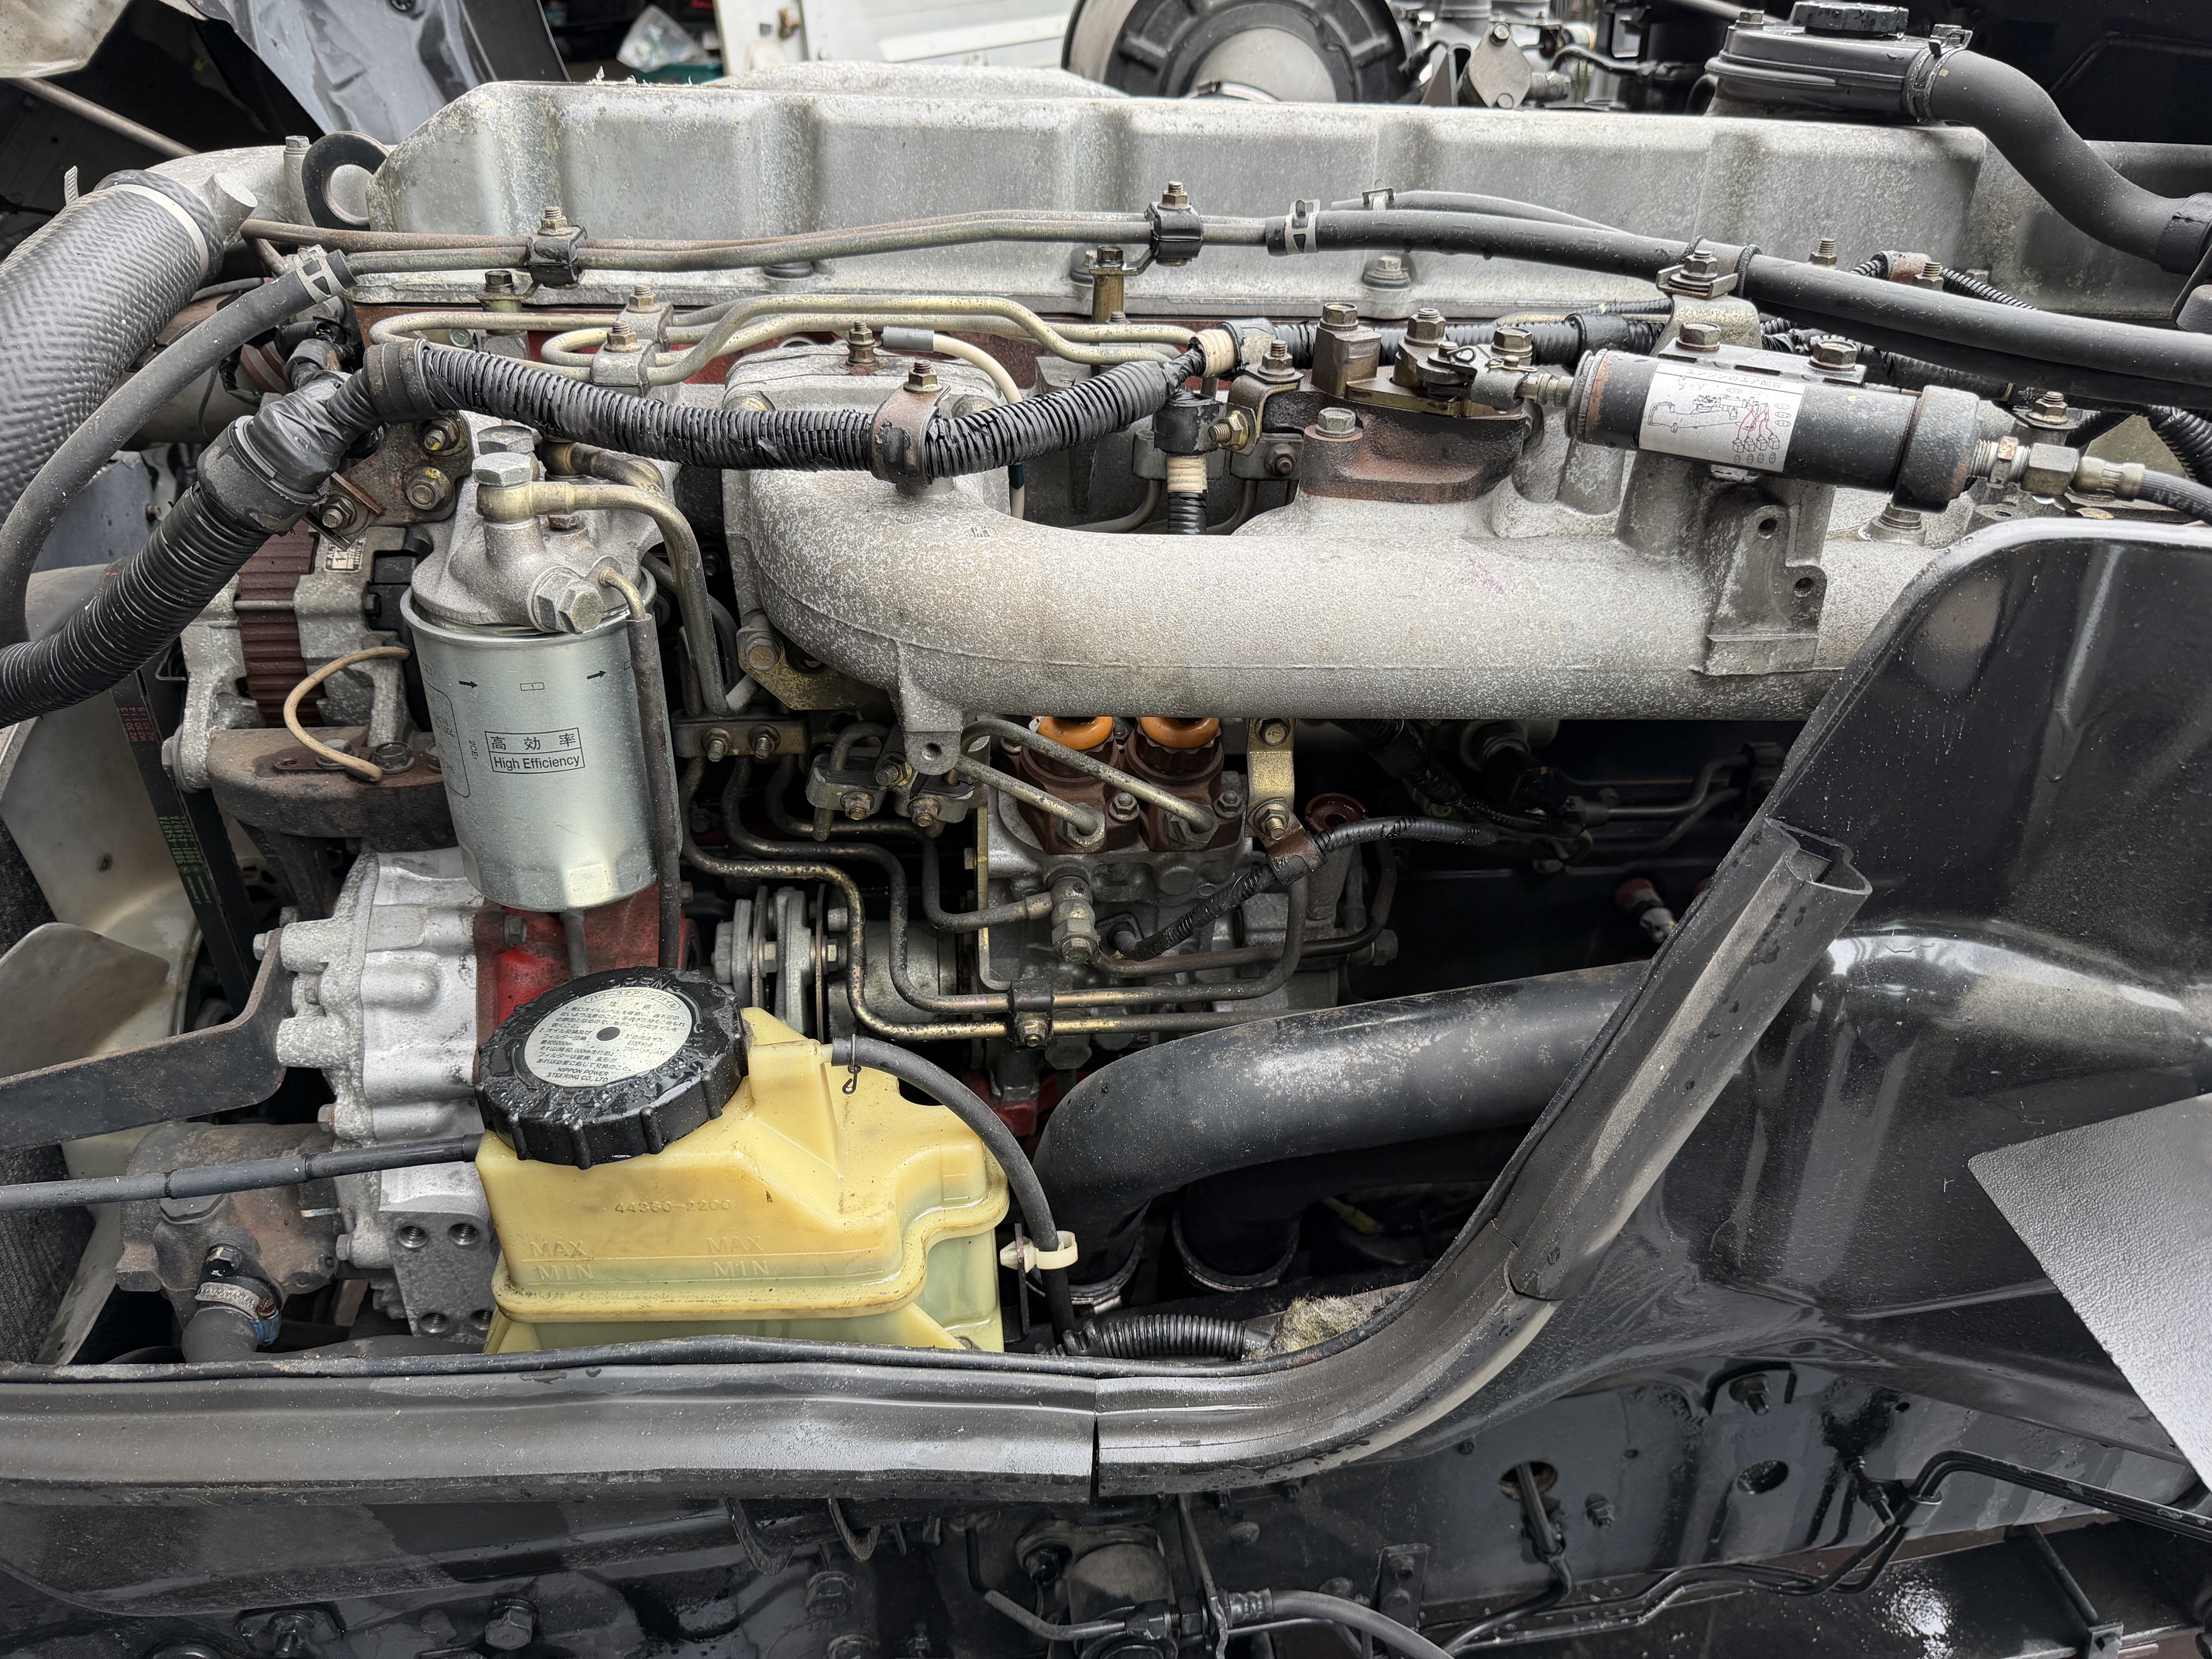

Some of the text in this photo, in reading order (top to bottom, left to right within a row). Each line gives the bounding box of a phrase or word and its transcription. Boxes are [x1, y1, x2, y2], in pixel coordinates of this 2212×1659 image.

[490, 733, 576, 750] 高効率
[493, 755, 580, 771] High Efficiency
[530, 1240, 587, 1257] MAX
[706, 1235, 764, 1252] MAX
[537, 1264, 594, 1280] MIN
[713, 1260, 769, 1277] MIN
